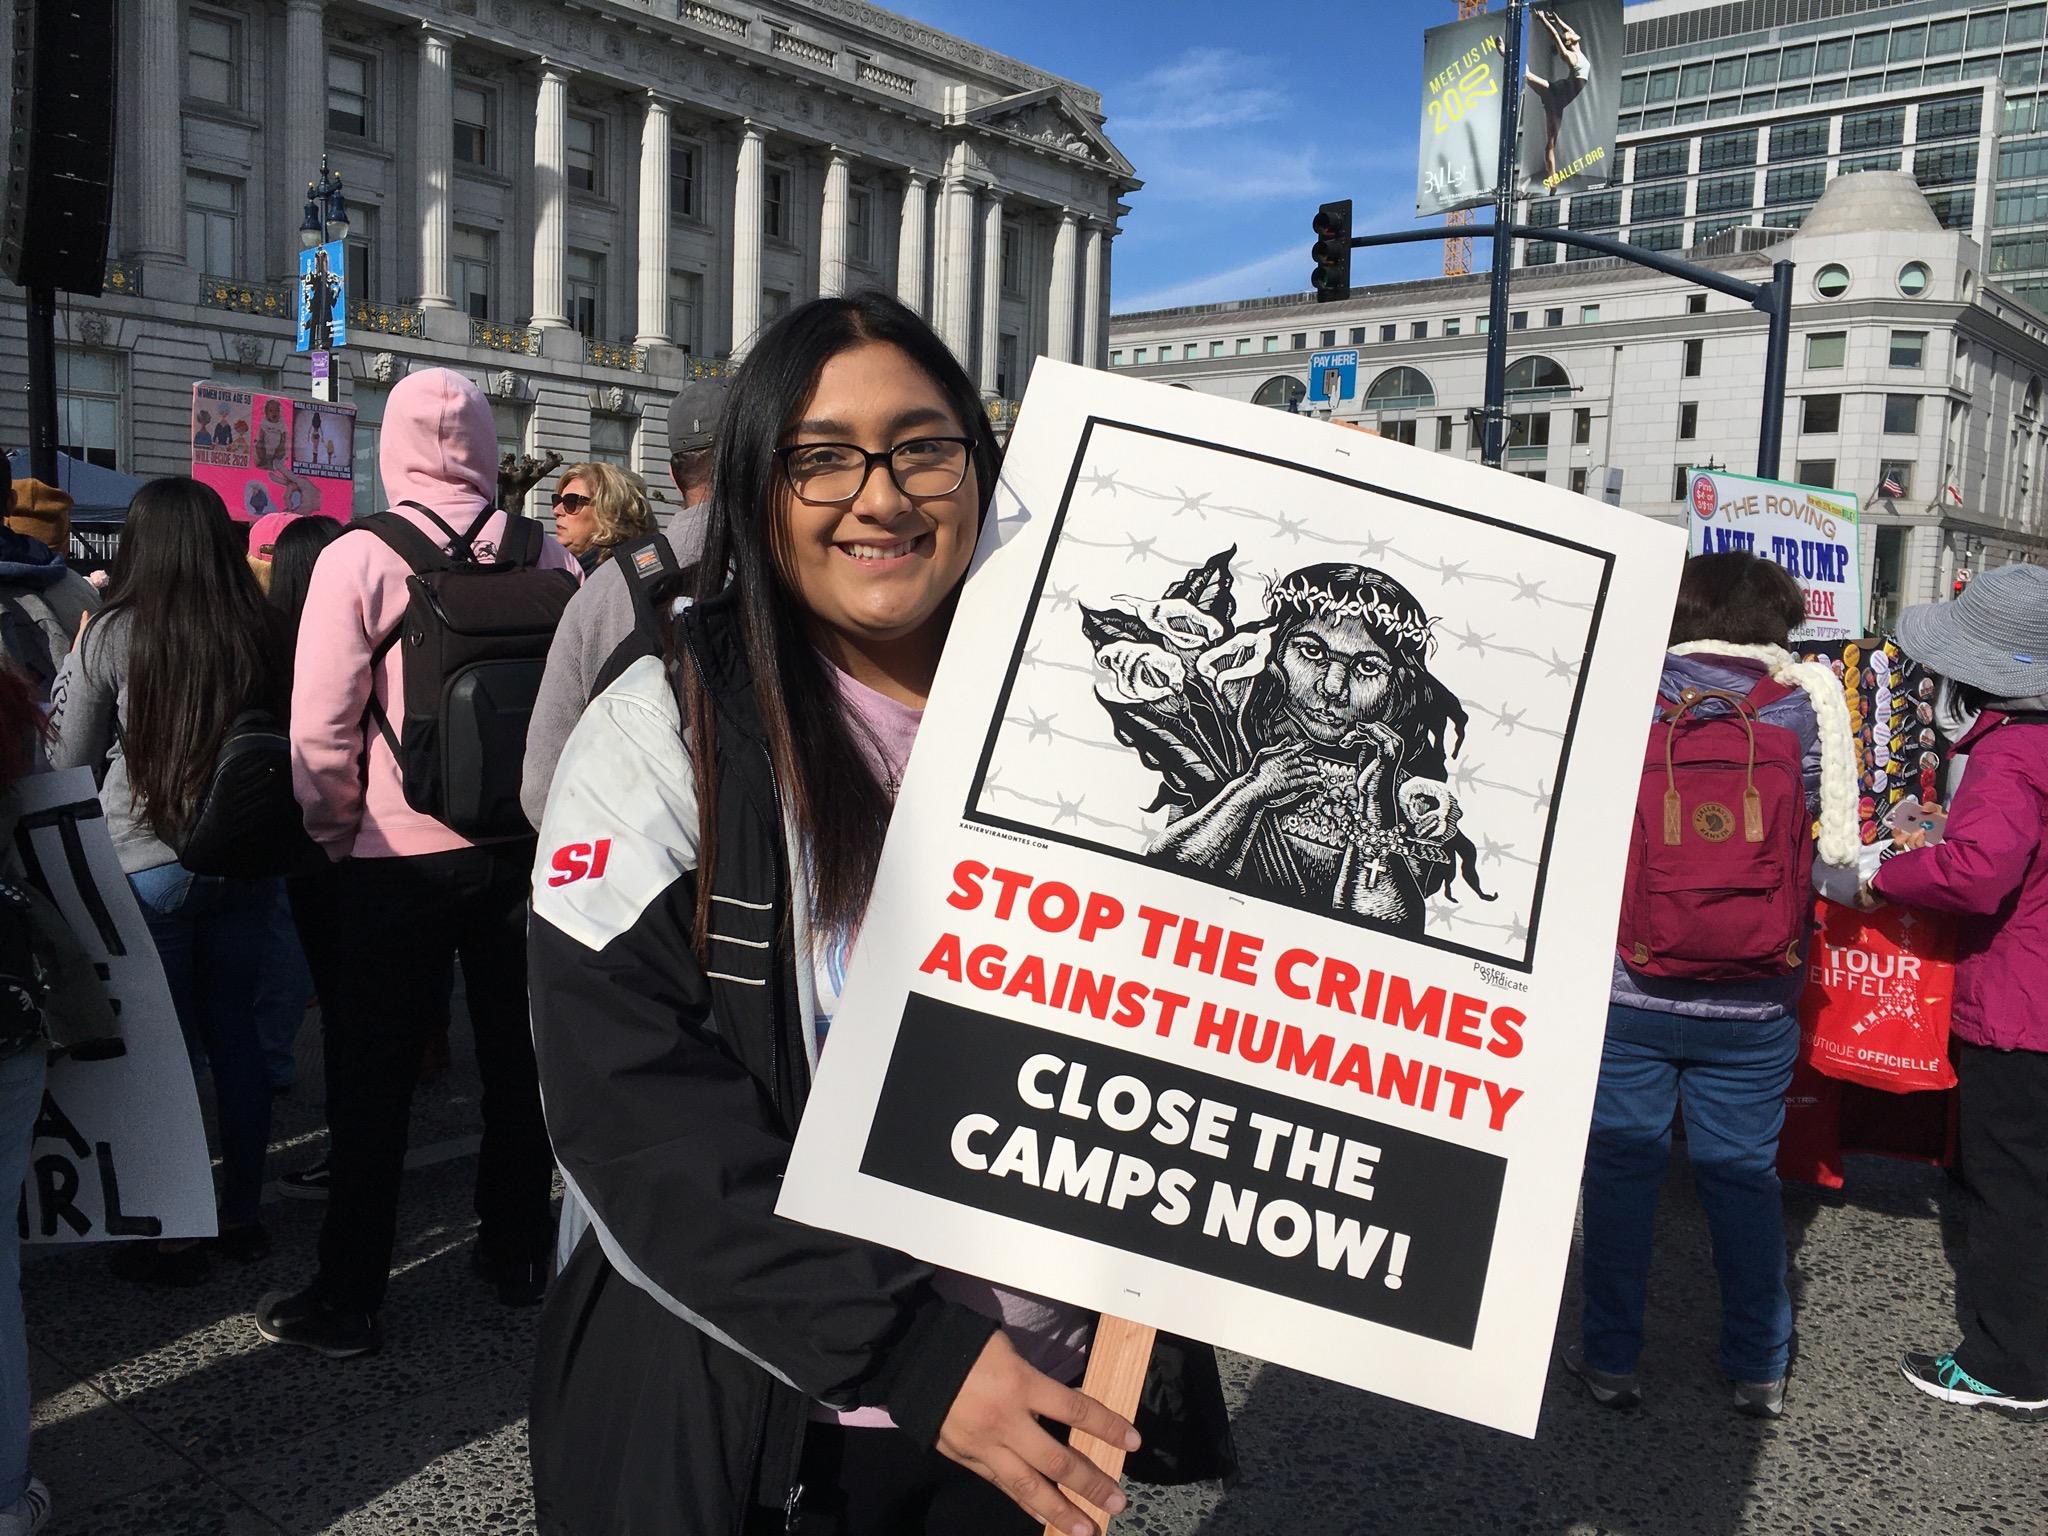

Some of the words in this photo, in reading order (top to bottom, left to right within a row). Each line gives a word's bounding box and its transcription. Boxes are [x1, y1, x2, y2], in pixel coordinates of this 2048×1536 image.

[1429, 61, 1462, 95] MEET
[1464, 47, 1481, 69] US
[1482, 35, 1497, 56] IN
[1543, 146, 1606, 191] SFBALLET.ORG
[1313, 355, 1331, 368] PAY
[1331, 353, 1356, 366] HERE
[232, 454, 248, 467] 2020
[1720, 496, 1760, 523] THE
[1765, 494, 1837, 541] ROVING
[1804, 589, 1835, 617] GON
[547, 838, 613, 888] SI
[948, 861, 1124, 942] STOP
[1139, 906, 1264, 985] THE
[1275, 948, 1525, 1058] CRIMES
[1473, 962, 1506, 978] Poster
[1480, 971, 1529, 993] Syndicate
[1810, 965, 1893, 997] EIFFEL
[1825, 943, 1921, 980] TOUR
[918, 934, 1189, 1036] AGAINST
[1194, 1003, 1523, 1131] HUMANITY
[1858, 1048, 1938, 1072] OFFICIELLE
[33, 1088, 92, 1160] A
[1018, 1054, 1237, 1159] CLOSE
[1249, 1113, 1381, 1200] THE
[951, 1114, 1196, 1225] CAMPS
[1203, 1181, 1410, 1289] NOW!
